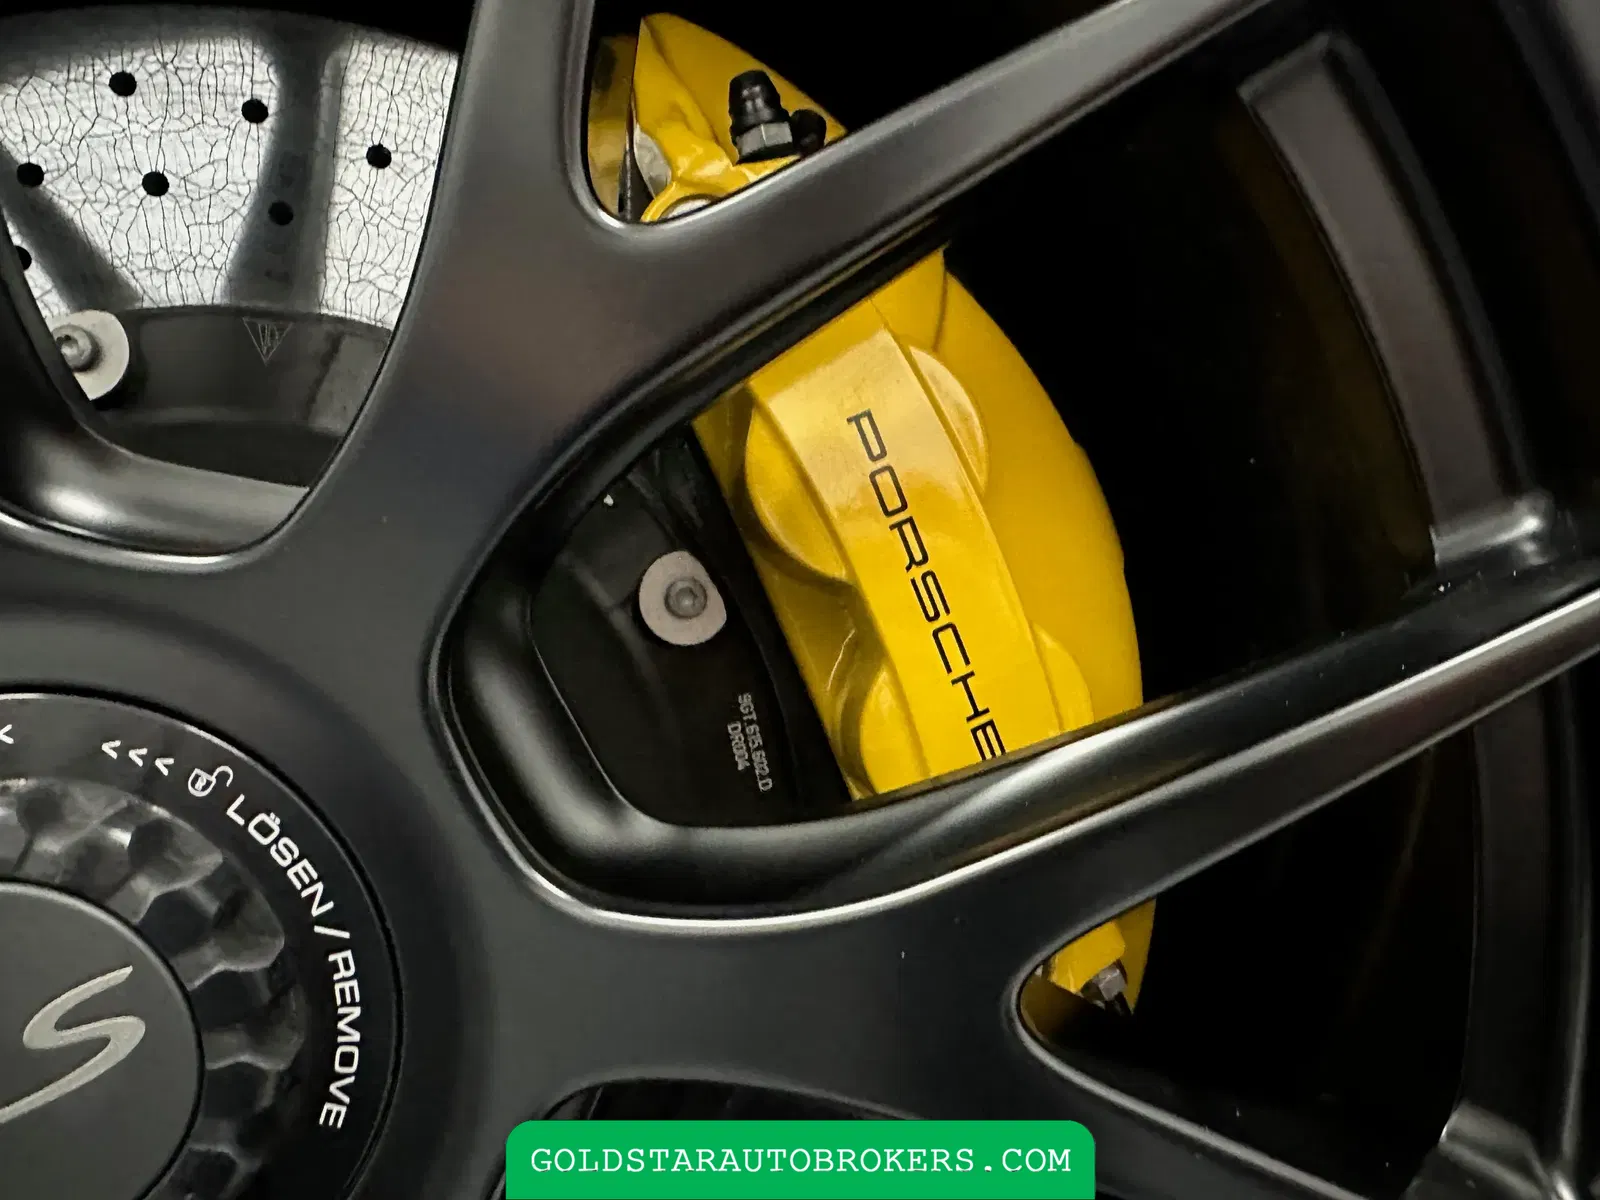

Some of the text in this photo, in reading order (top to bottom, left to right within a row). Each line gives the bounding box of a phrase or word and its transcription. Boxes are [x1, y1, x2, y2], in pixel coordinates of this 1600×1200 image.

[846, 409, 1006, 760] PORSCHE
[226, 793, 335, 918] LÖSEN
[318, 949, 362, 1129] REMOVE
